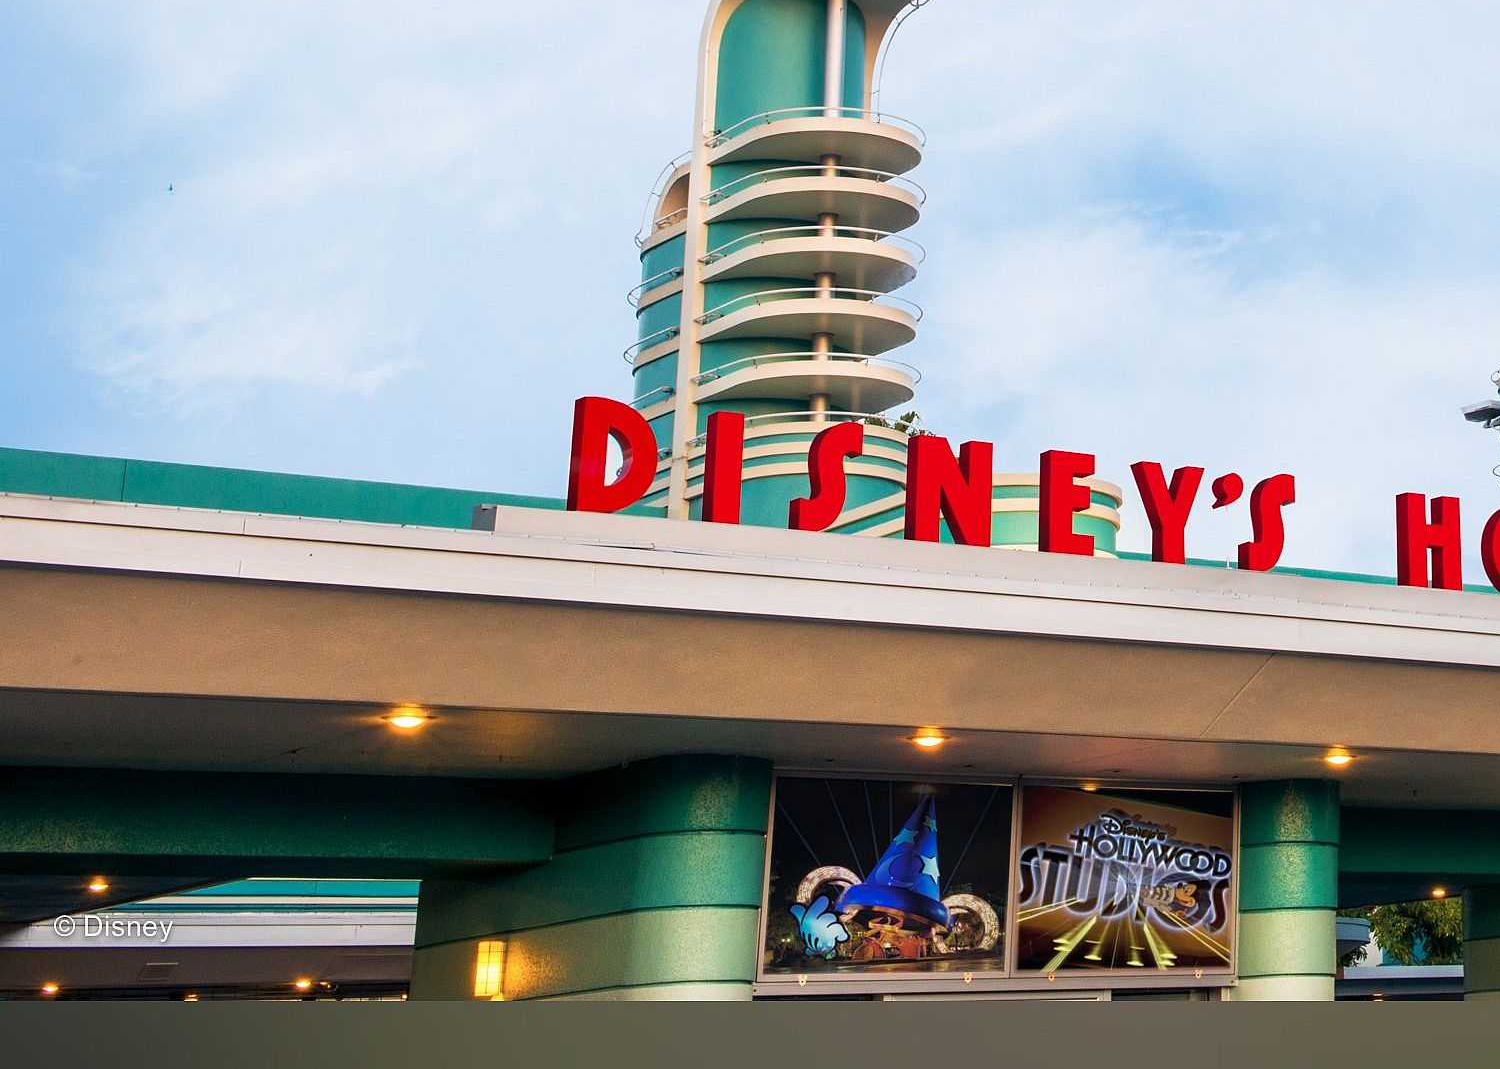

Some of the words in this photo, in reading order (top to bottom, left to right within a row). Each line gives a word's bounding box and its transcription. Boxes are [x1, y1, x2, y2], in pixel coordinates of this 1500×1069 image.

[566, 395, 1297, 573] DISNEY'S
[1018, 845, 1230, 932] STUDIOS
[1068, 827, 1231, 877] HOLLYWOOD
